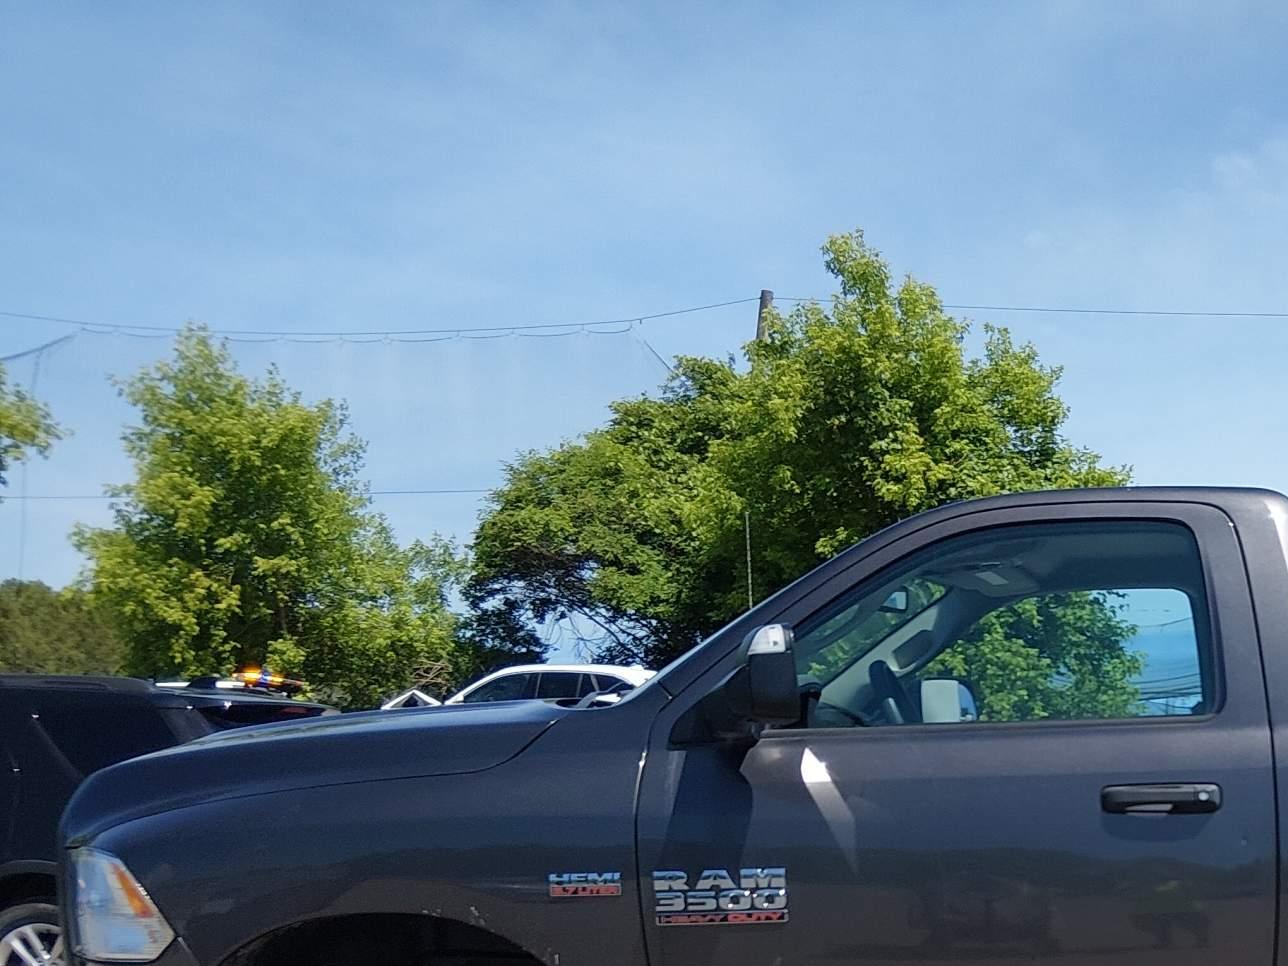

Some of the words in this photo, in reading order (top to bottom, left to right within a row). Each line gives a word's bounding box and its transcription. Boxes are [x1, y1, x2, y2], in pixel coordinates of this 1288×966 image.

[549, 872, 622, 885] HEMI
[653, 867, 786, 891] RAM
[655, 888, 787, 911] 3500
